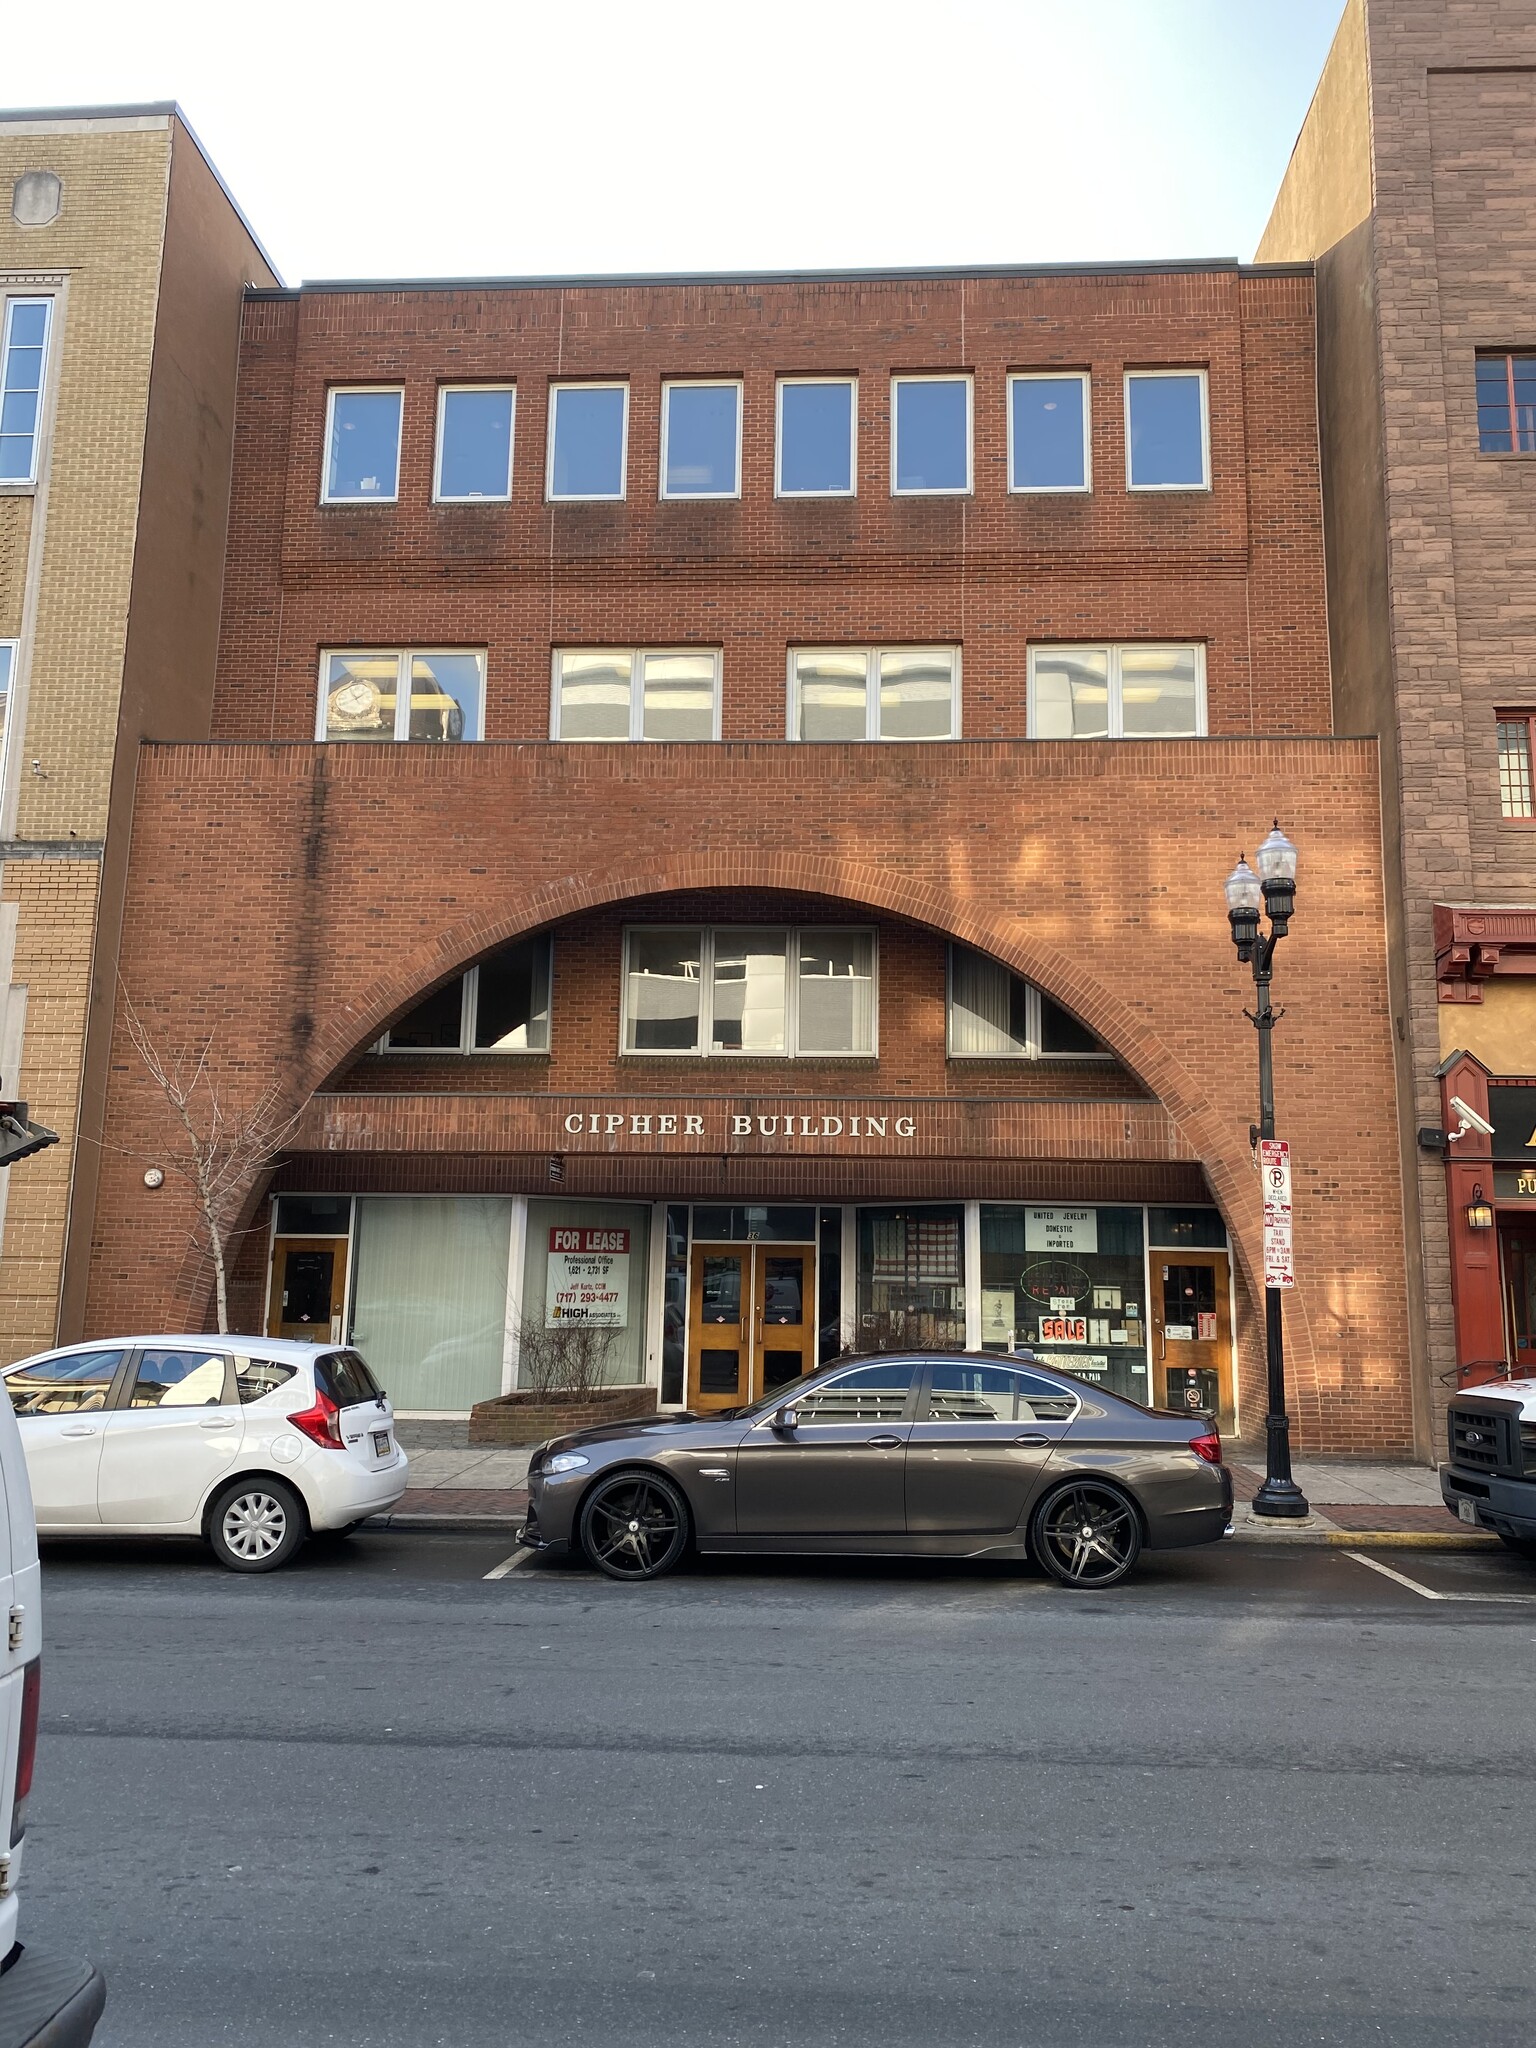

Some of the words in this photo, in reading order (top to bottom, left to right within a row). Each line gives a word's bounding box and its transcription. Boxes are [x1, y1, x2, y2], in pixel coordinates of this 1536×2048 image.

[565, 1114, 705, 1135] CIPHER
[732, 1115, 917, 1137] BUILDING
[1267, 1194, 1287, 1202] DECLARED
[1033, 1211, 1054, 1220] UNITED
[1062, 1212, 1088, 1221] JEWELRY
[1265, 1214, 1274, 1226] NO
[1274, 1216, 1290, 1225] PARKING
[1045, 1224, 1073, 1233] DOMESTIC
[1273, 1229, 1283, 1237] TAXI
[555, 1230, 580, 1250] FOR
[586, 1231, 625, 1251] LEASE
[748, 1232, 759, 1240] 36
[1046, 1240, 1074, 1248] IMPORTED
[1270, 1238, 1286, 1246] STAND
[564, 1255, 596, 1265] Professional
[598, 1256, 614, 1265] Office
[1276, 1255, 1280, 1263] &
[602, 1266, 609, 1275] SF
[1032, 1285, 1080, 1296] REPAIR
[556, 1292, 577, 1303] (717)
[562, 1308, 589, 1319] HIGH
[1042, 1317, 1085, 1341] SALE
